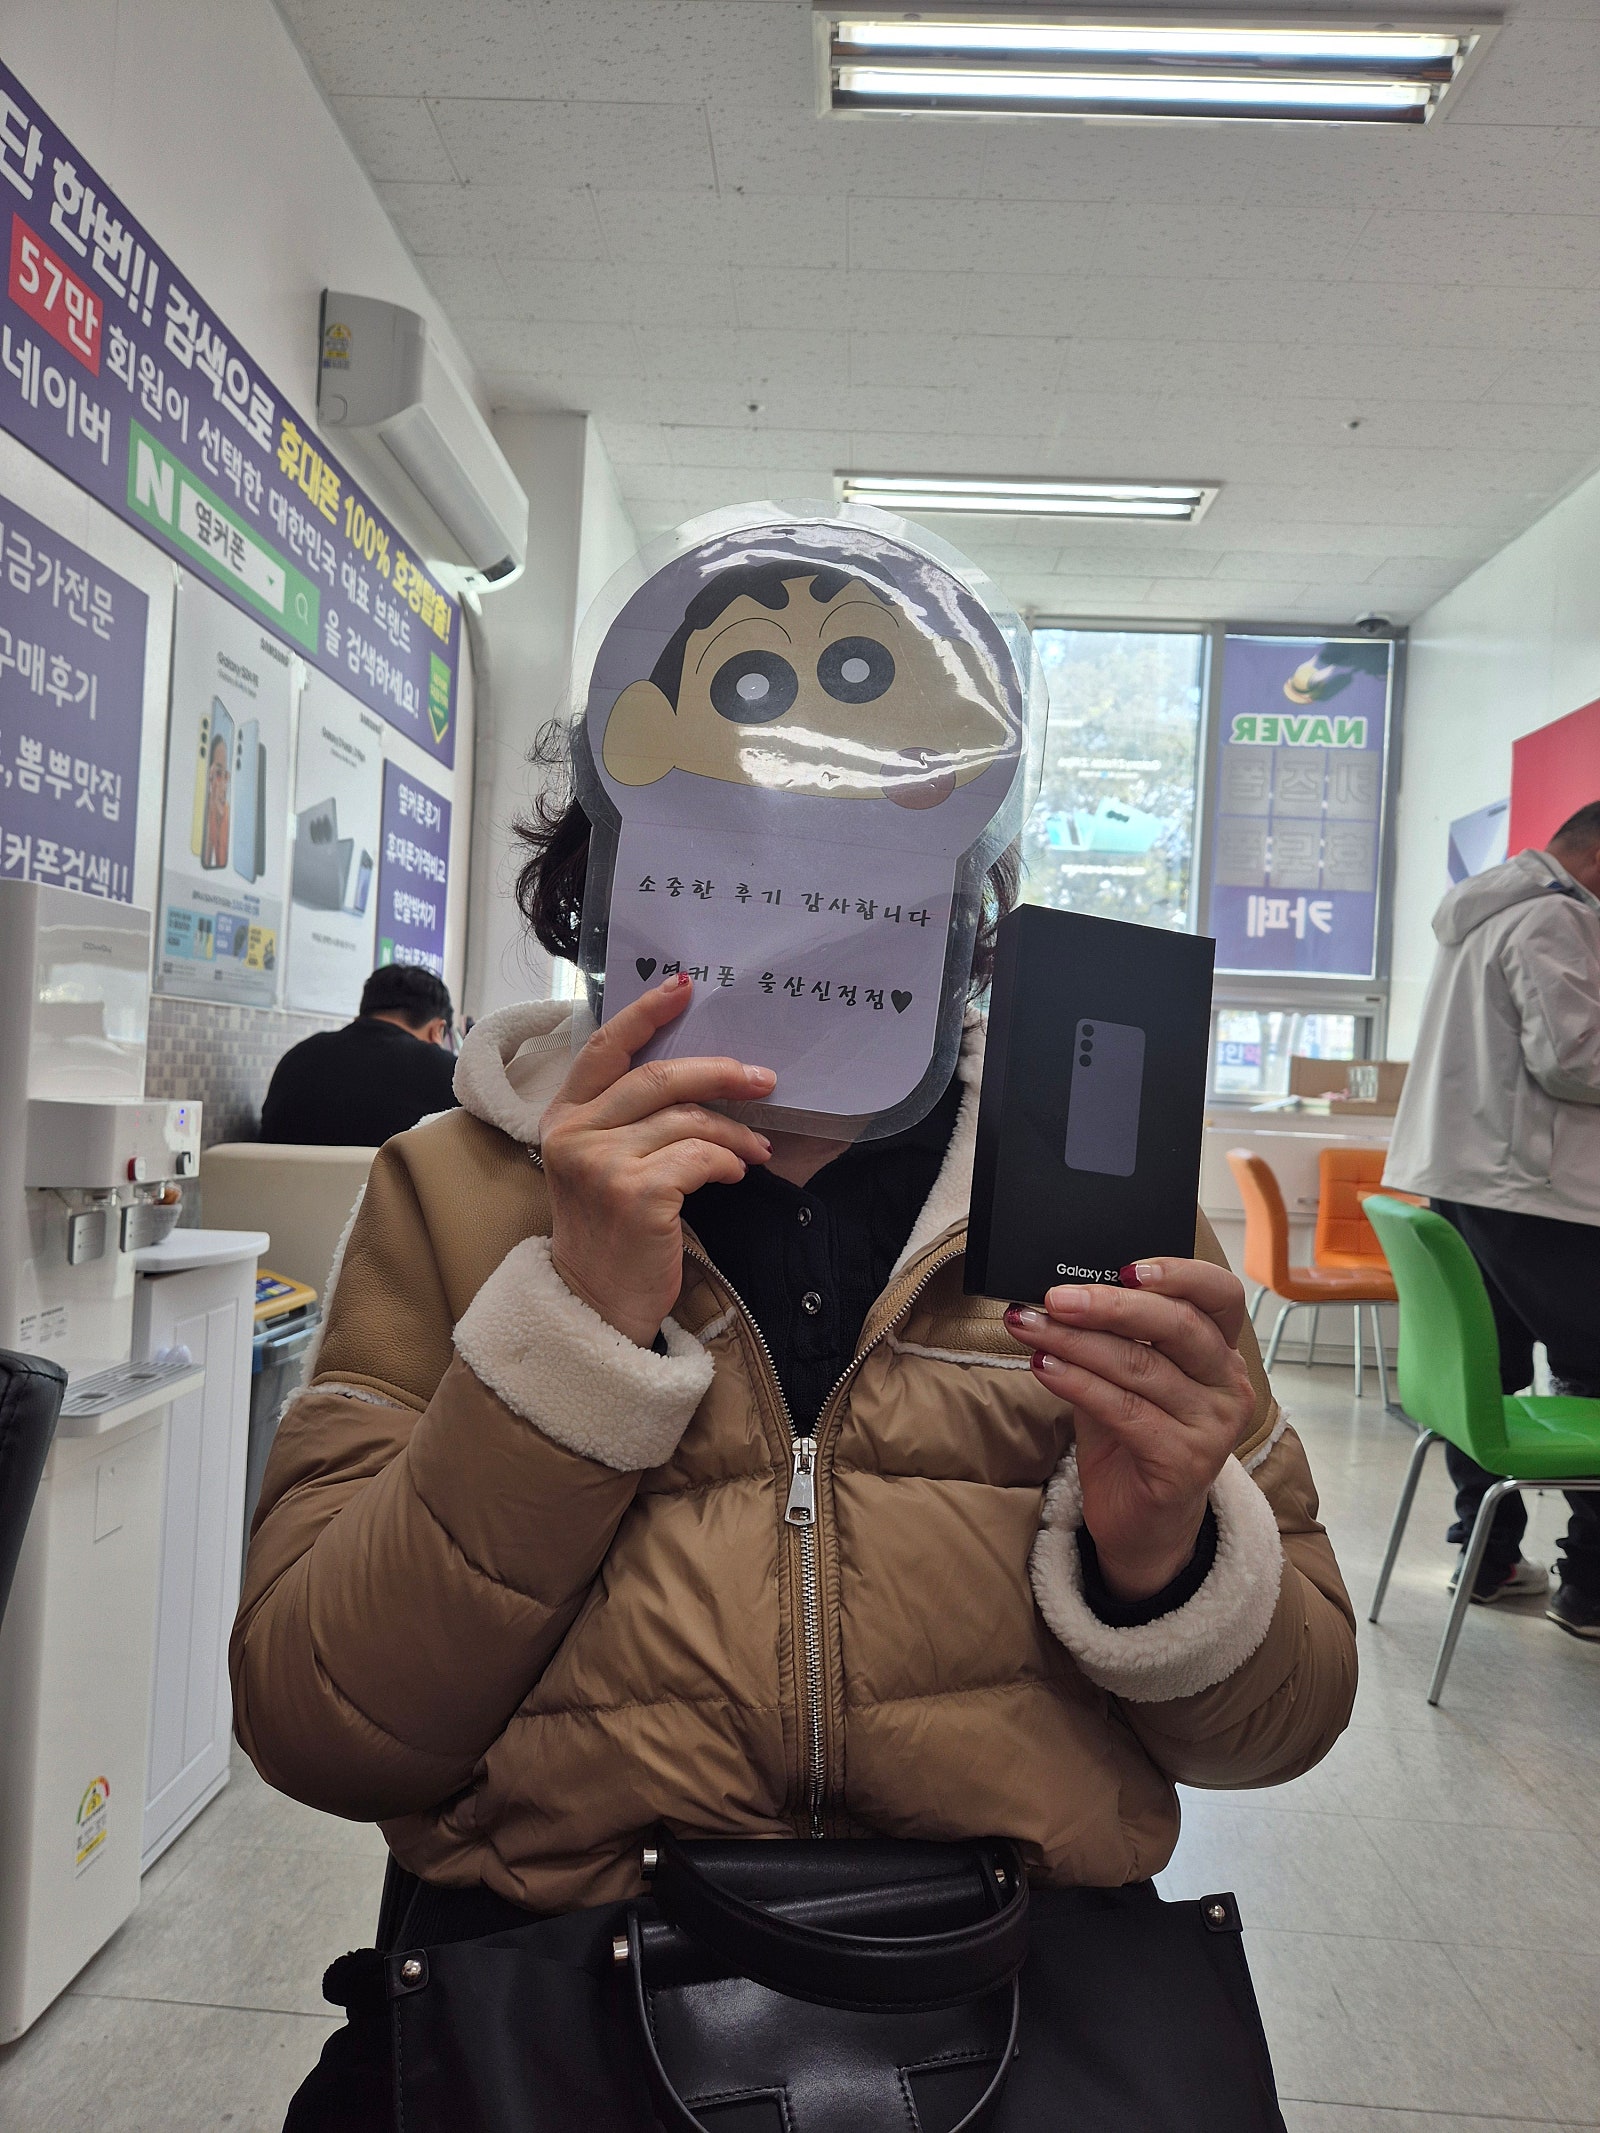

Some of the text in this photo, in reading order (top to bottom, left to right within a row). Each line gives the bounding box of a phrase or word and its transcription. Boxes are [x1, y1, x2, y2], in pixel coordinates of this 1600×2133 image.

[19, 235, 411, 654] 57만 회원이 선택한 대한민국 대표 브랜드
[50, 157, 159, 327] 한번!!
[165, 283, 275, 453] 검색으로
[277, 418, 341, 526] 휴대폰
[344, 495, 390, 578] 100%
[392, 550, 452, 645] 호갱탈출!
[3, 324, 111, 466] 네이버
[135, 438, 175, 525] N
[196, 501, 246, 573] 옆커폰
[324, 608, 342, 658] 을
[347, 627, 419, 719] 검색하세요!
[0, 521, 114, 641] 금가전문
[0, 826, 128, 903] 커폰검색!!
[638, 875, 931, 927] 소중한 후기 감사합니다
[757, 971, 884, 1010] 울산신정점
[1056, 1263, 1121, 1282] Galaxy S2
